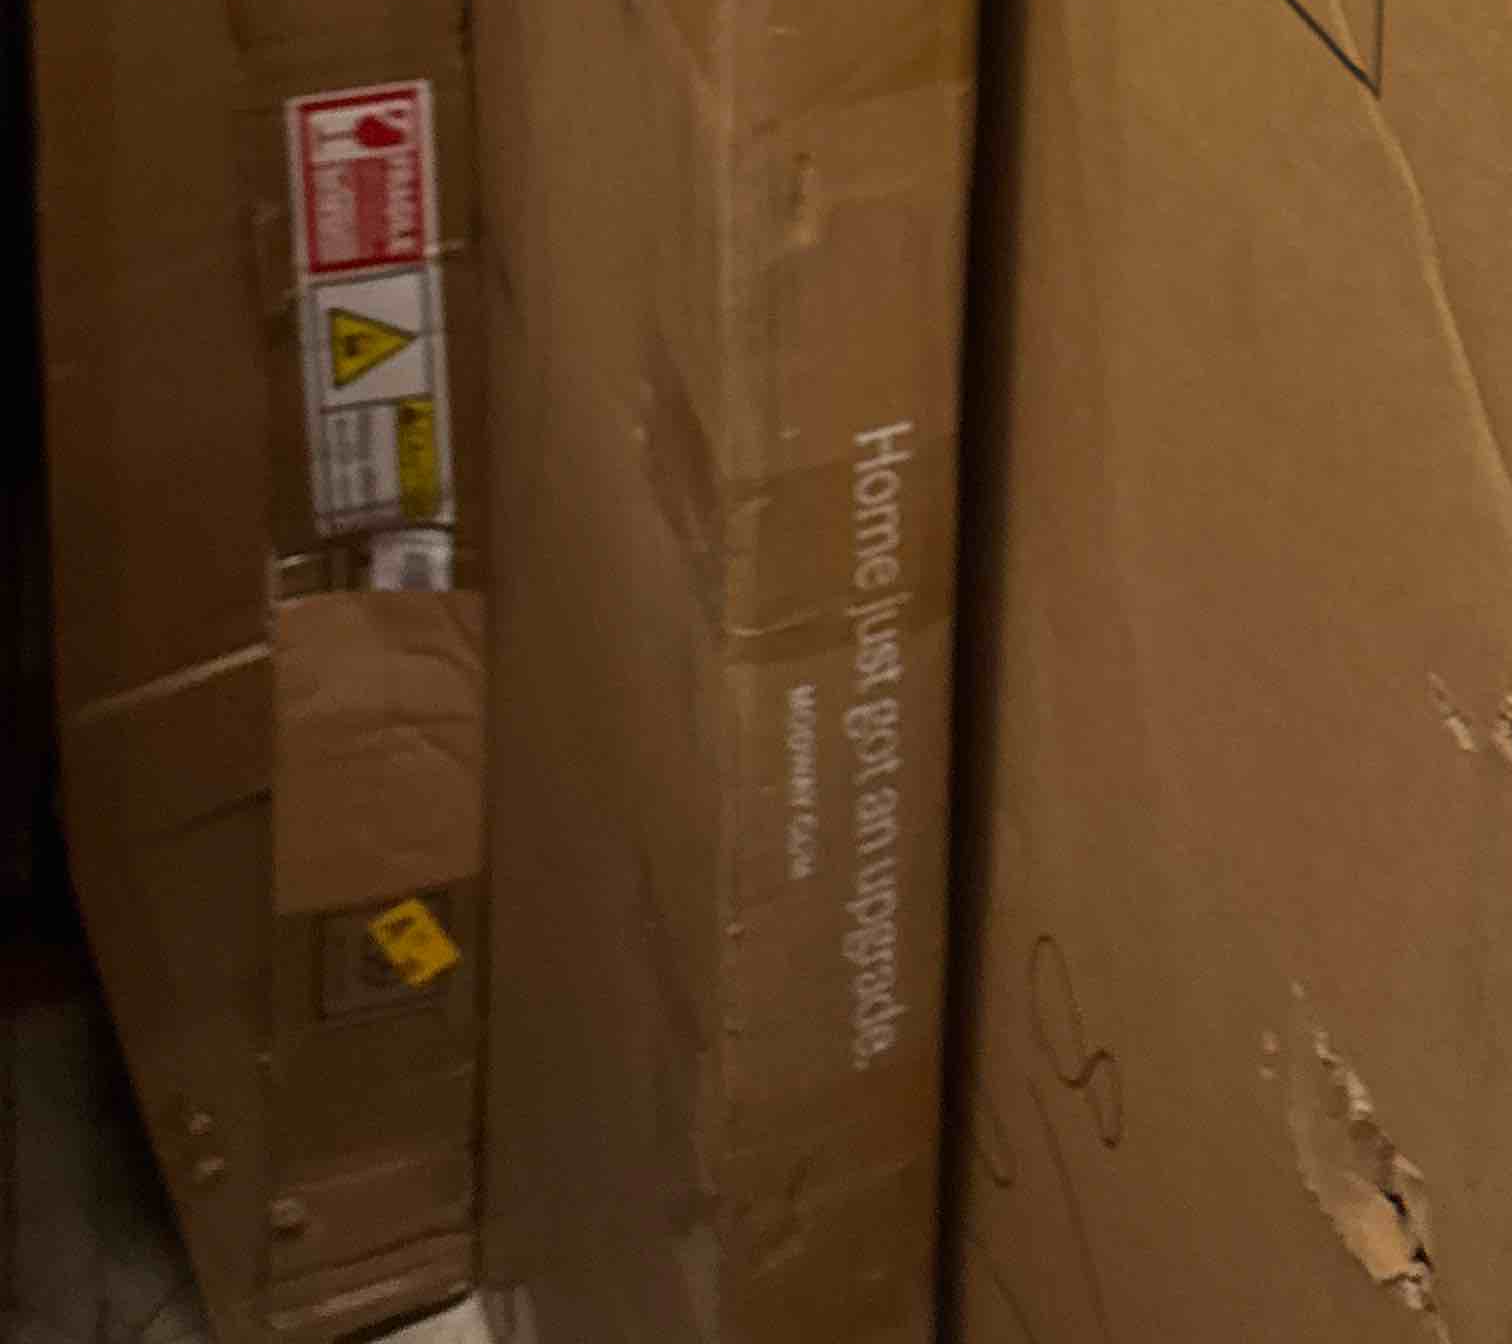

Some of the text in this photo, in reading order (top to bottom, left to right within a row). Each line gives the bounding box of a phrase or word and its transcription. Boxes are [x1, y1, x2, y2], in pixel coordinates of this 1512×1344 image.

[847, 418, 914, 590] Home
[842, 598, 909, 688] just
[842, 698, 903, 784] got
[852, 788, 900, 851] an
